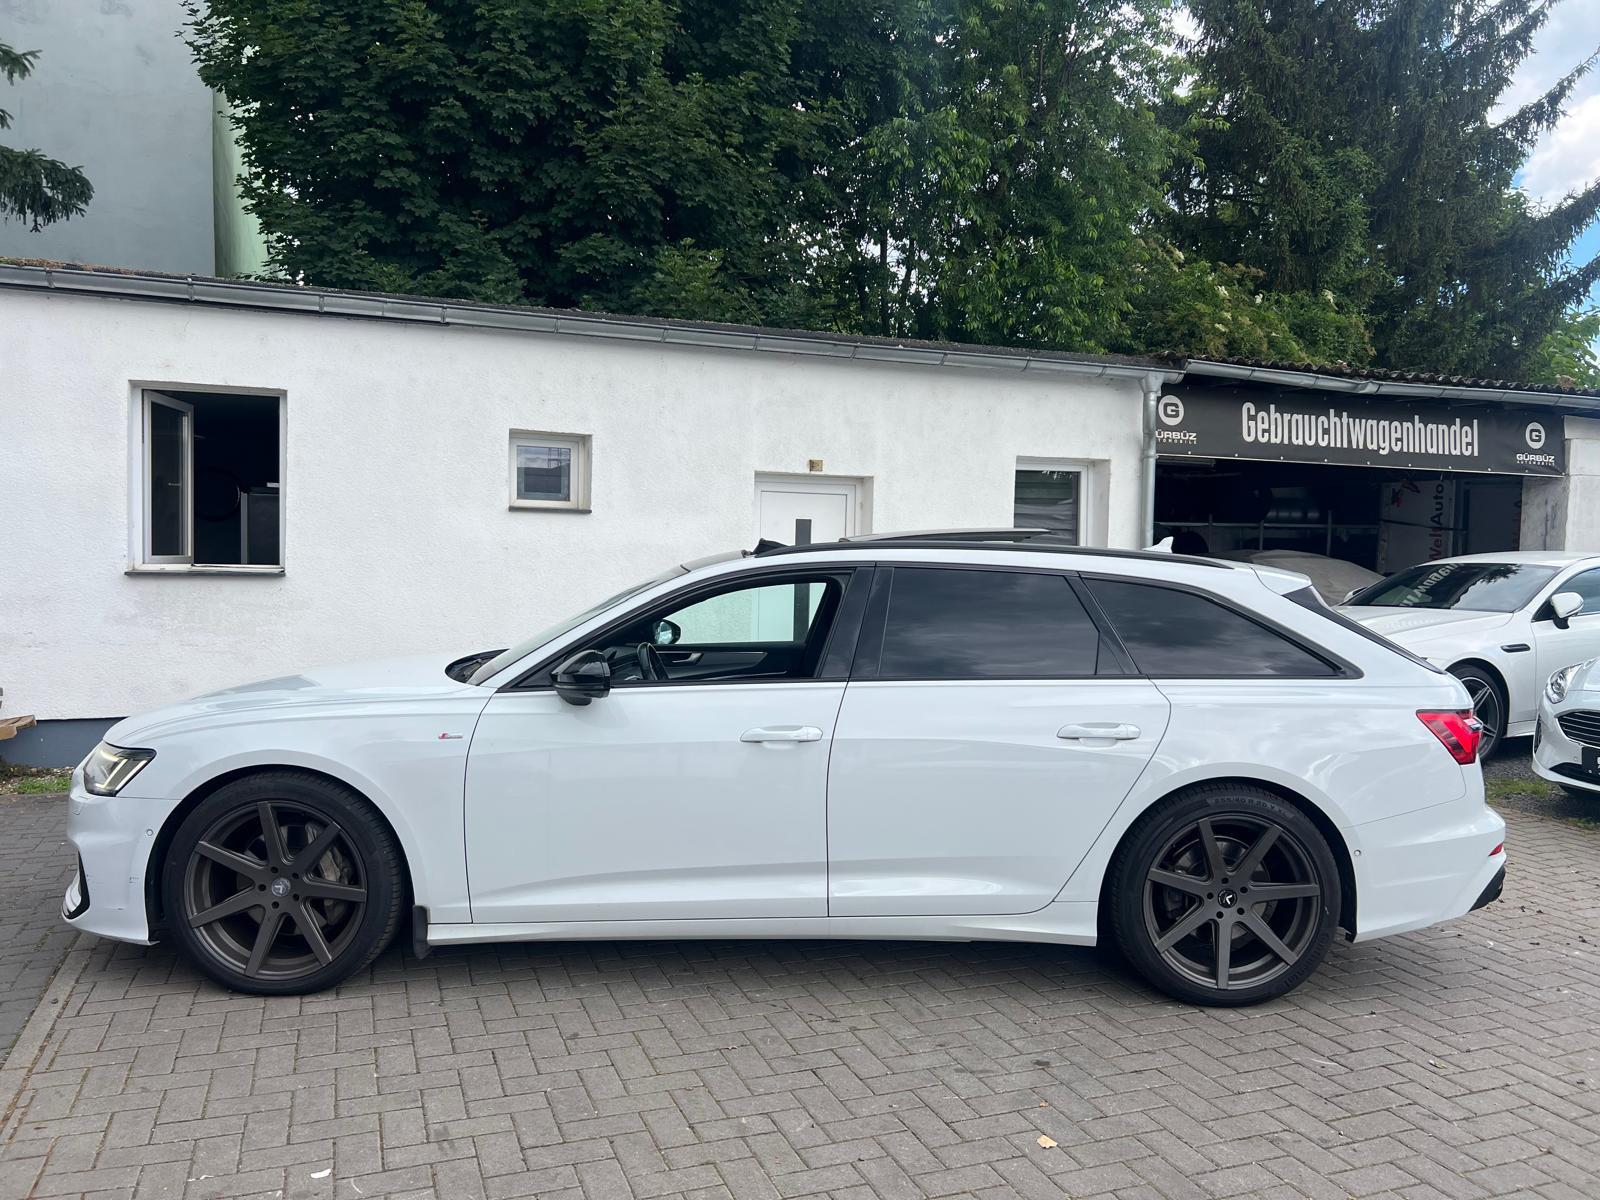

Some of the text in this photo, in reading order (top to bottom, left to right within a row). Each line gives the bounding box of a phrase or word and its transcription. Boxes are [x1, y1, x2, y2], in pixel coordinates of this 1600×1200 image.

[1156, 429, 1197, 440] ÜRBÜZ
[1242, 402, 1479, 457] Gebrauchtwagenhandel
[1516, 452, 1555, 463] GÜRBÜZ
